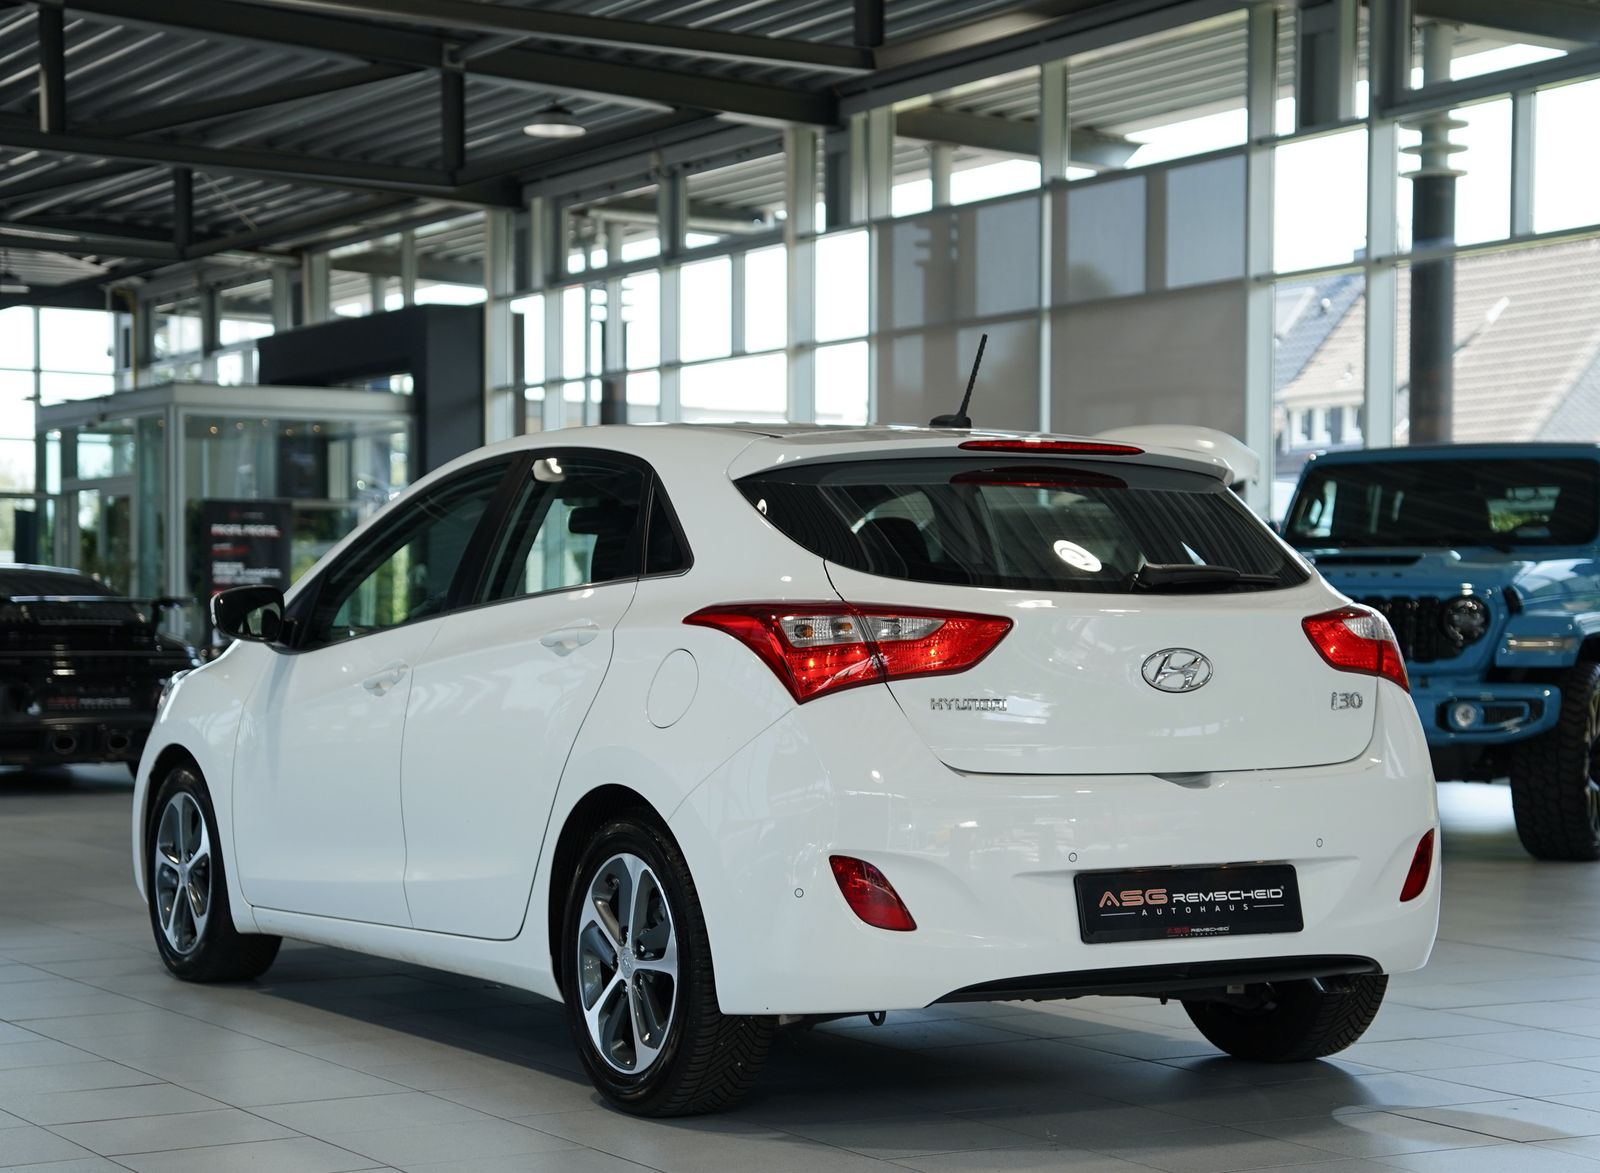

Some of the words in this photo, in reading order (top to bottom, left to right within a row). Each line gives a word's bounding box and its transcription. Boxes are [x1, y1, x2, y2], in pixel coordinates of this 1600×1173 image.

[930, 698, 1008, 711] HYUNDAI
[1331, 691, 1363, 711] i30
[1099, 888, 1168, 908] ASG
[1141, 903, 1248, 916] AUTOHAUS
